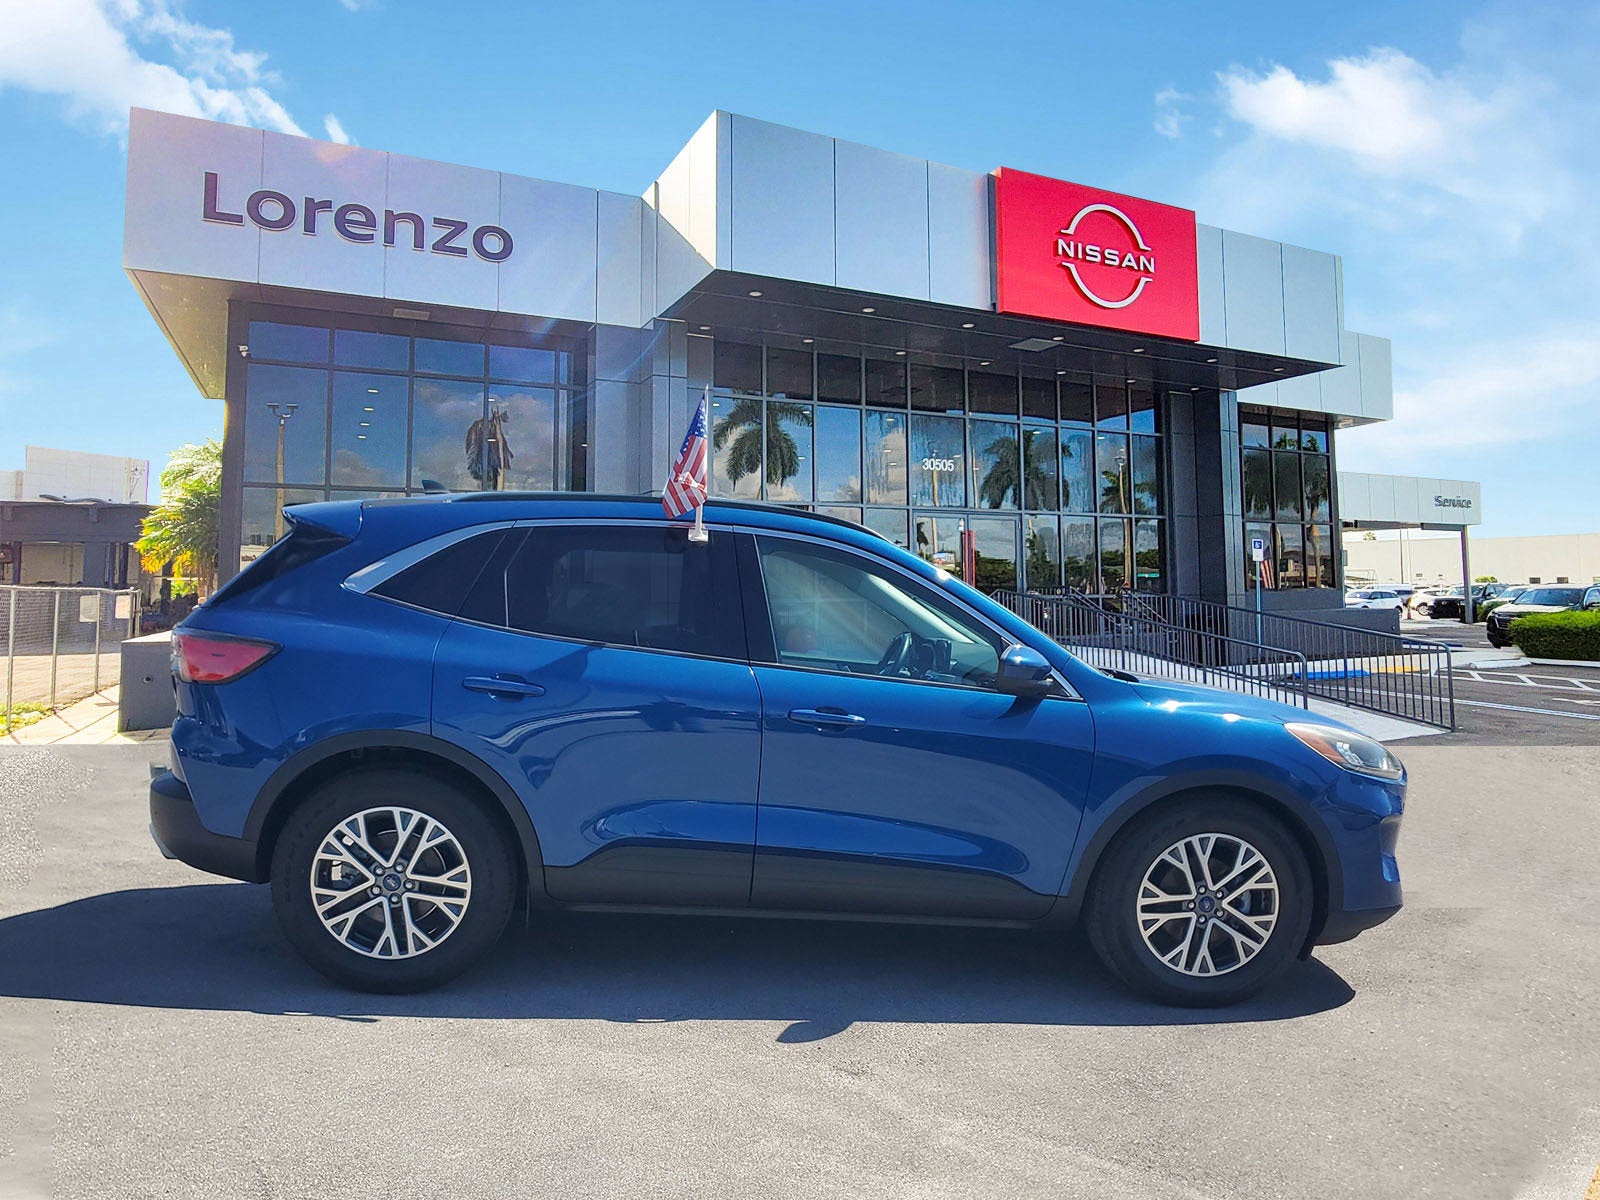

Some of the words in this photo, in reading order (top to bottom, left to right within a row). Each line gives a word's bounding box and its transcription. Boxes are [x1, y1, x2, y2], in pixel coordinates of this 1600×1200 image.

[203, 171, 514, 262] Lorenzo
[1057, 238, 1155, 273] NISSAN
[922, 458, 954, 471] 30505
[1434, 495, 1472, 508] Service
